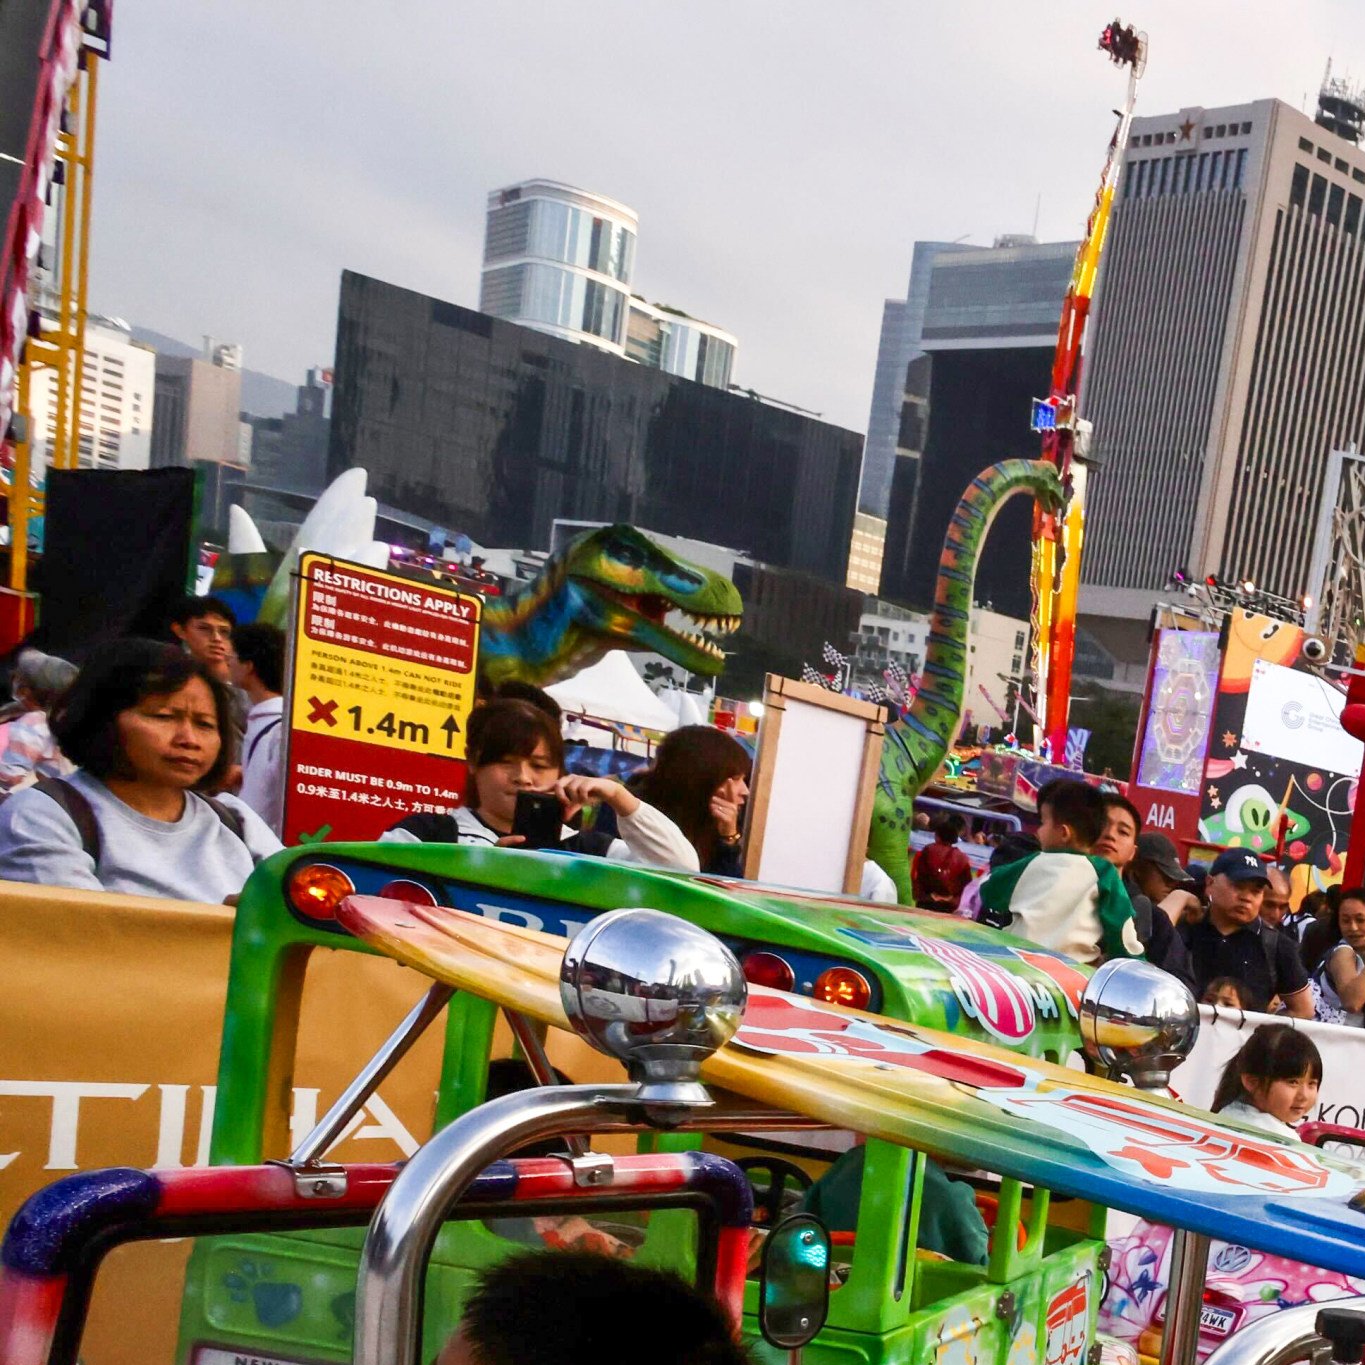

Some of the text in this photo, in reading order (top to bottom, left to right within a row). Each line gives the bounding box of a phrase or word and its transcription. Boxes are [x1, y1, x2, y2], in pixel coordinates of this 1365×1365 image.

[313, 568, 421, 607] RESTRICTIONS
[424, 597, 470, 619] APPLY
[311, 650, 347, 663] PERSON
[350, 658, 378, 671] ABOVE
[403, 670, 422, 680] CAN
[424, 675, 441, 685] NOT
[443, 679, 462, 689] RIDE
[347, 705, 429, 744] 1.4m
[297, 764, 459, 800] RIDER MUST BE 0.9m TO 1.4m
[1146, 803, 1175, 830] AIA
